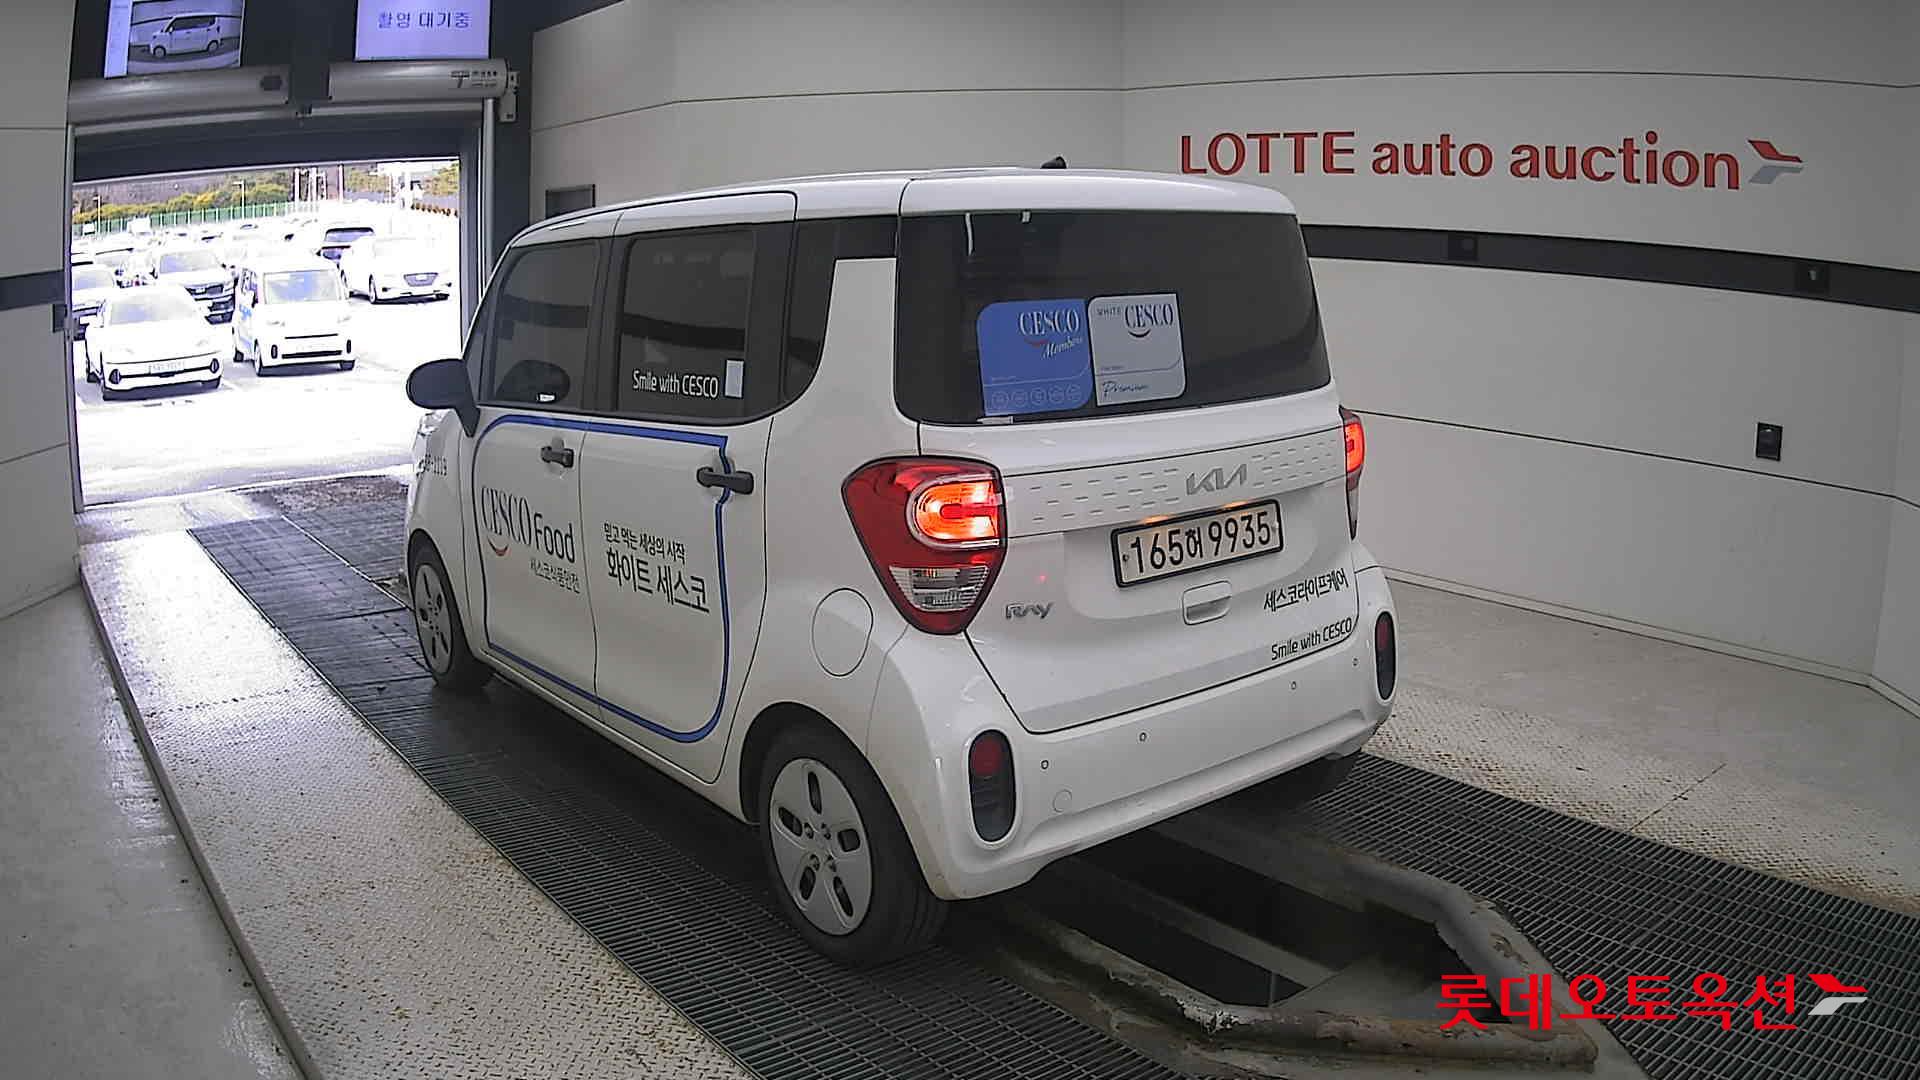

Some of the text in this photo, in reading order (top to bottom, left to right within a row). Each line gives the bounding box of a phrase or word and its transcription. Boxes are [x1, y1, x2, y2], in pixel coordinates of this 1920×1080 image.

[419, 11, 469, 29] 대기중
[1180, 130, 1741, 191] LOTTE auto auction
[1019, 308, 1080, 336] CESCO
[1124, 303, 1175, 329] CESCO
[632, 369, 719, 399] Smile with CESCO
[1185, 463, 1248, 496] KIA
[481, 486, 576, 564] CESCO Food
[603, 522, 686, 566] 믿고 먹는 세상의 시작
[1207, 511, 1271, 557] 9935
[606, 546, 711, 614] 화이트 세스코
[1263, 567, 1349, 613] 세스코라이프케어
[1005, 602, 1055, 620] Ray
[1271, 616, 1353, 661] Smile with CESCO
